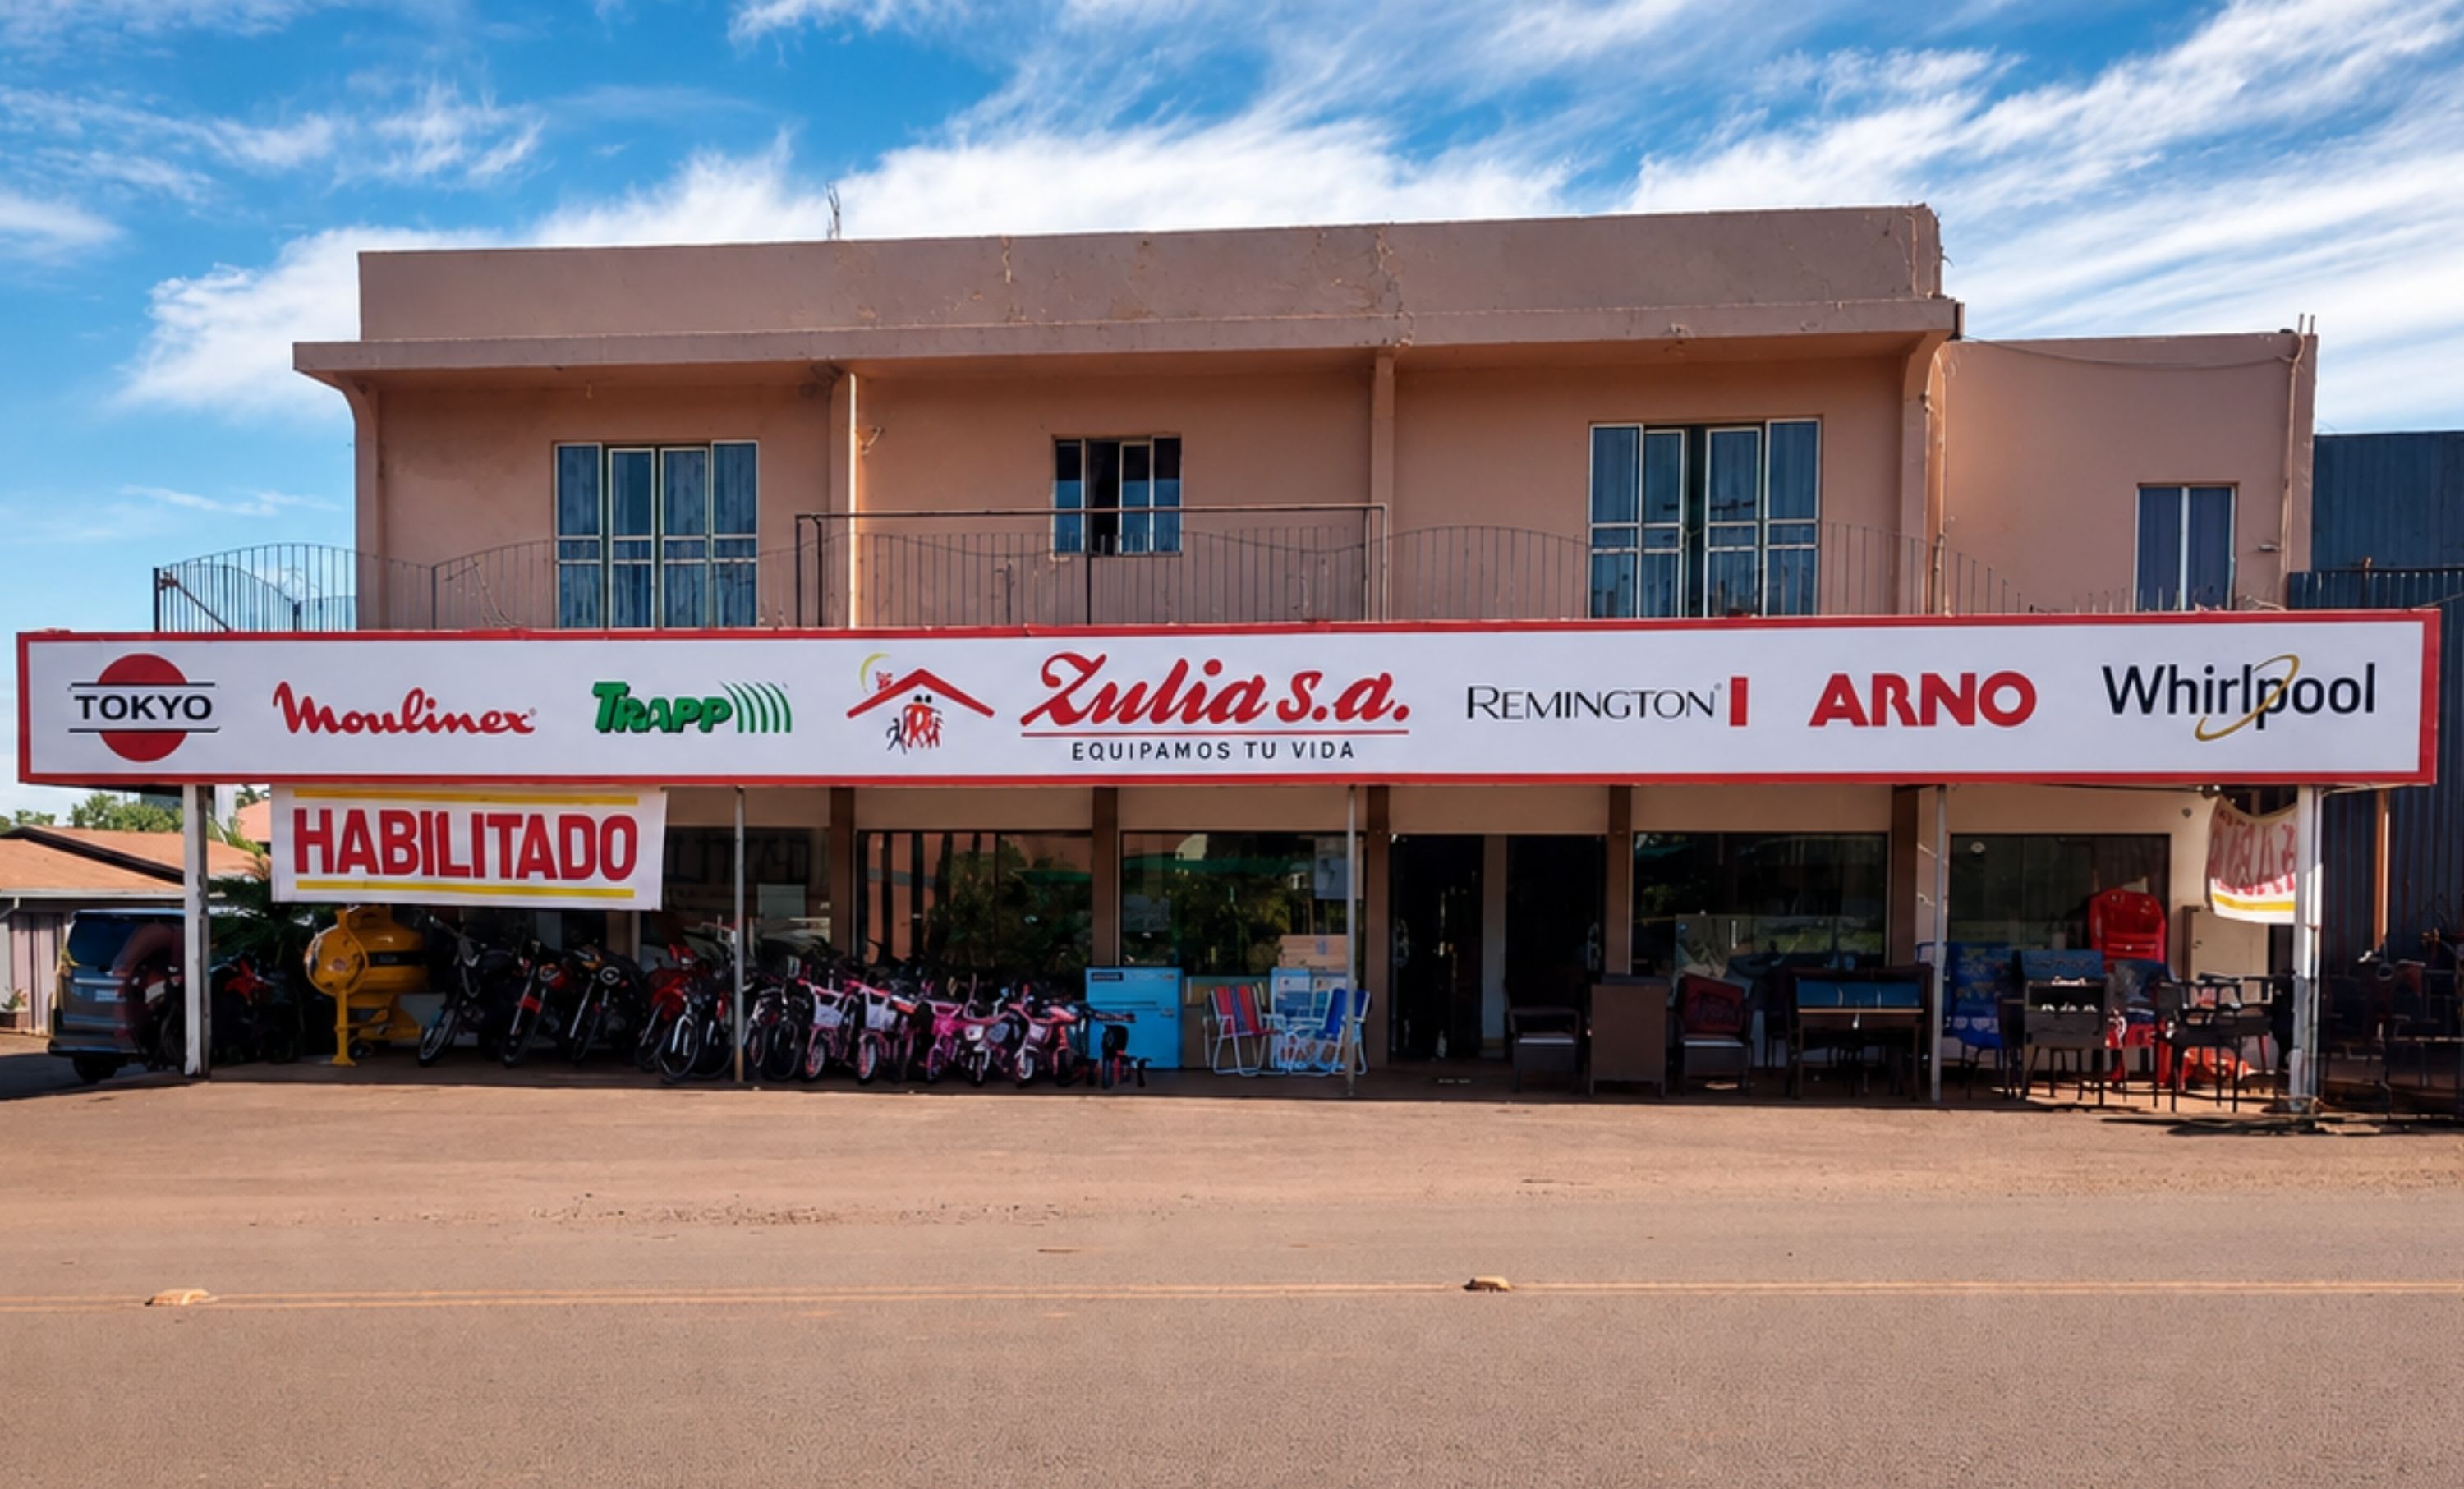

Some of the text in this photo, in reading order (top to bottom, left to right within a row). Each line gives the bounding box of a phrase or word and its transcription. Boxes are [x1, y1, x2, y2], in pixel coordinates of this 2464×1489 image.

[74, 695, 212, 720] TOKYO
[273, 681, 536, 734] Moulinex
[1020, 653, 1268, 726] Zulia
[1467, 686, 1715, 719] REMINGTON
[1809, 671, 2037, 727] ARNO
[2102, 662, 2376, 730] Whirlpool
[1072, 741, 1354, 761] EQUIPAMOS TU VIDA
[292, 808, 638, 881] HABILITADO
